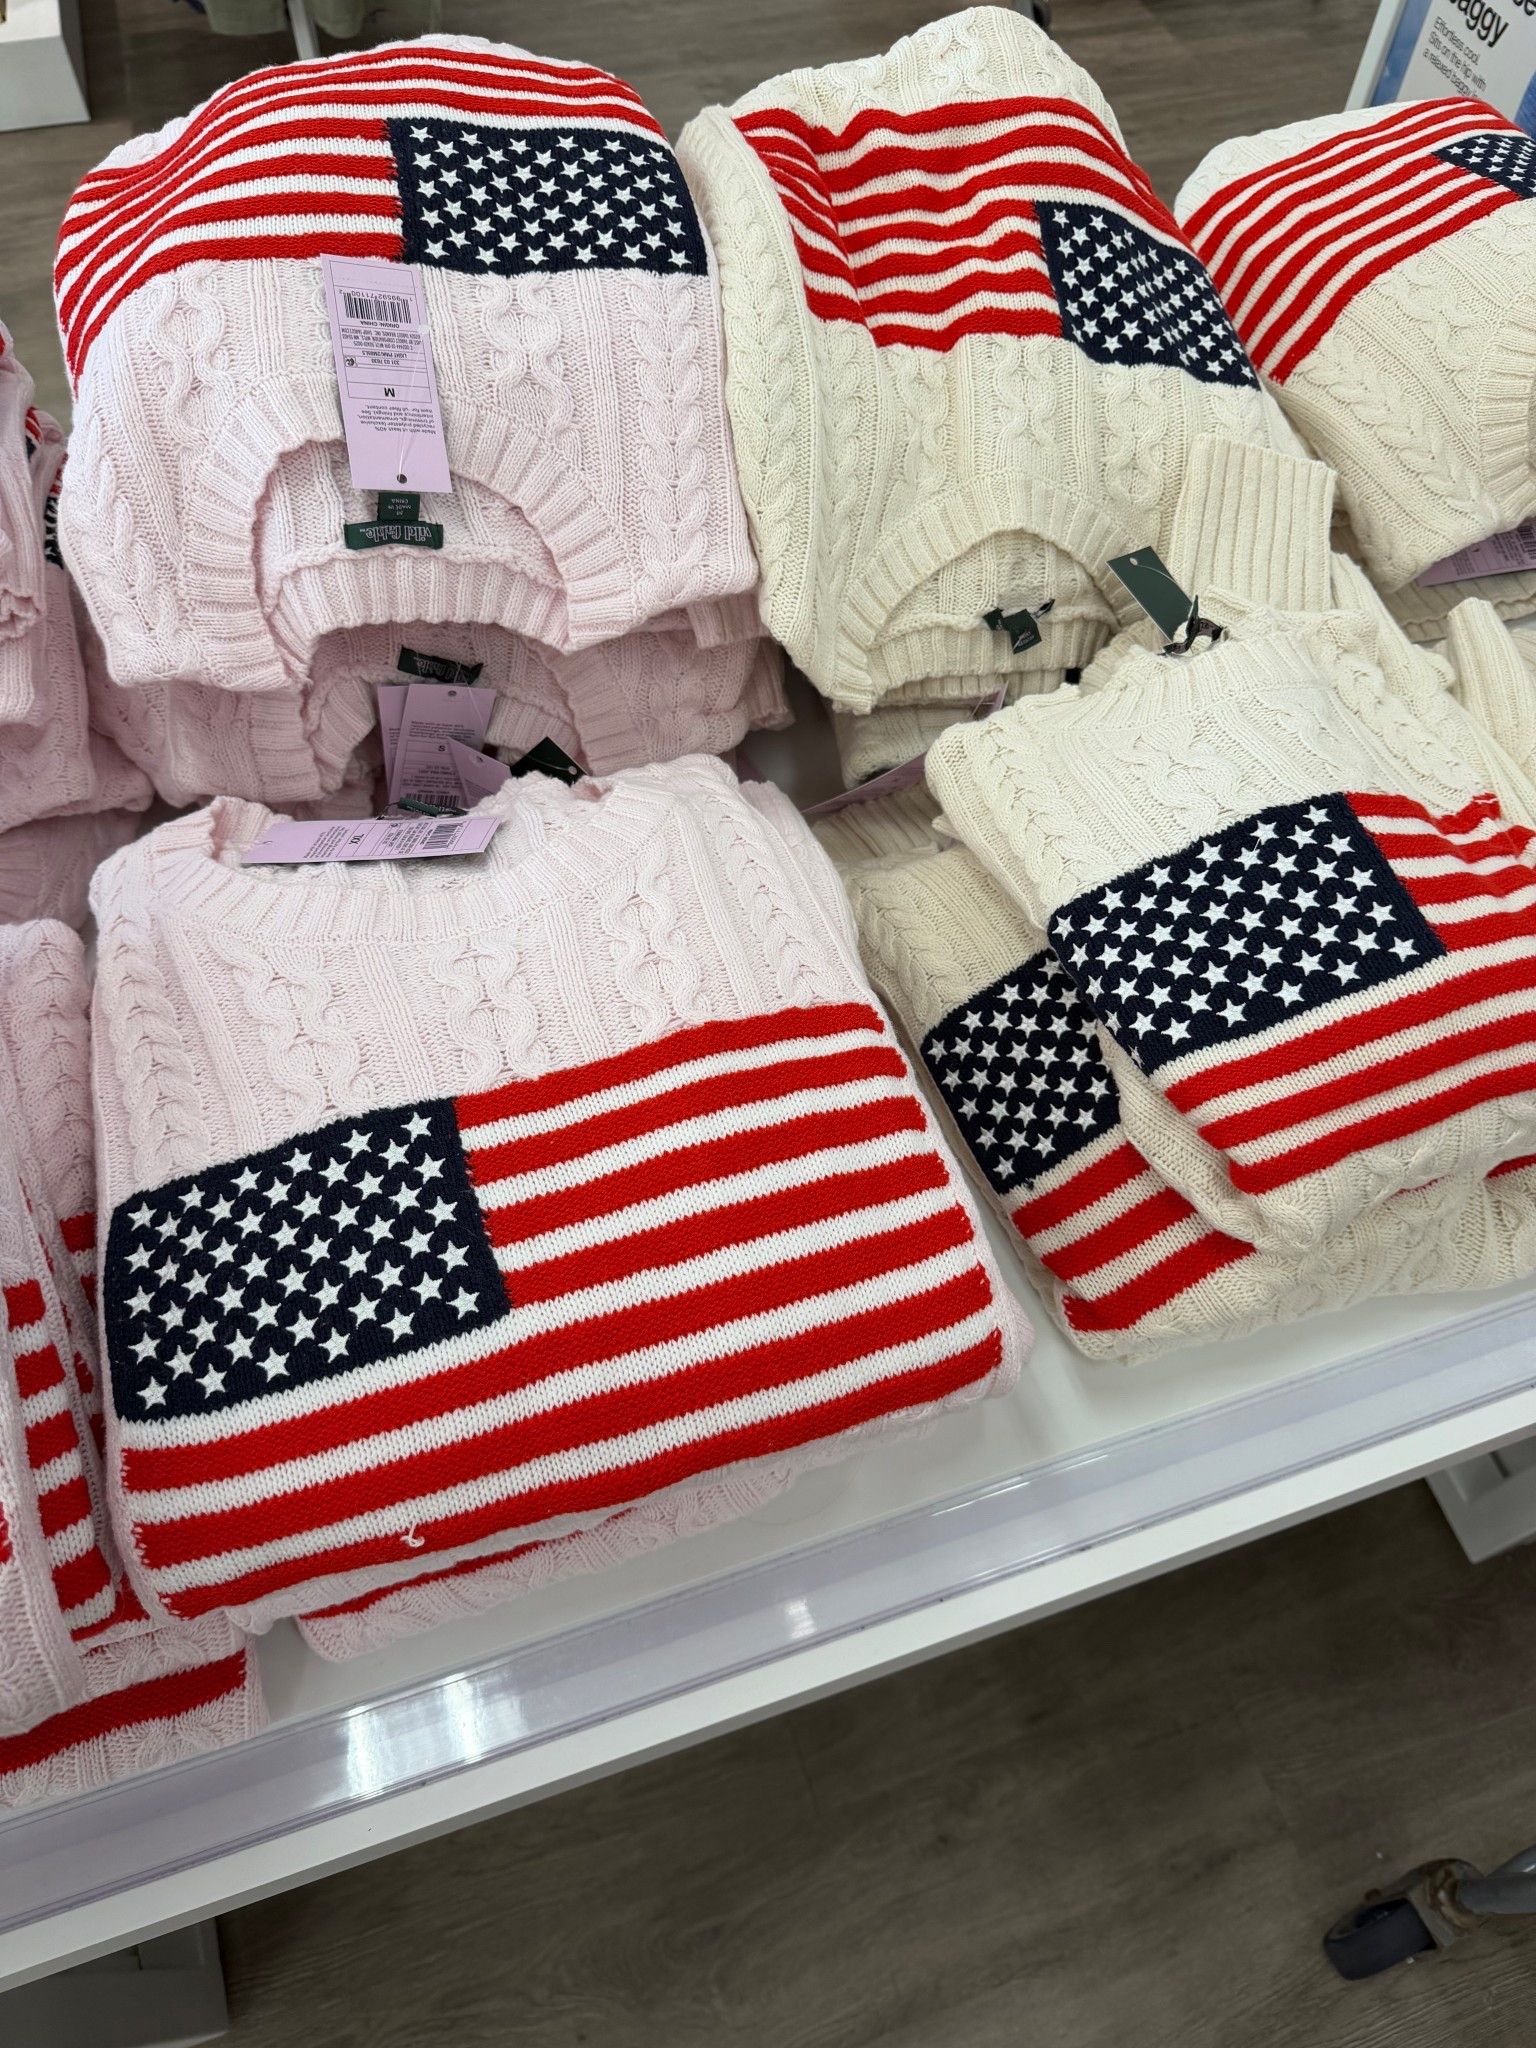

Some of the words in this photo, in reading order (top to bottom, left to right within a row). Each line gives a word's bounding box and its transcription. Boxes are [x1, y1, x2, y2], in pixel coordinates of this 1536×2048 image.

[1440, 45, 1451, 58] on
[1450, 51, 1462, 68] the
[384, 387, 396, 397] M
[348, 833, 364, 845] XXL
